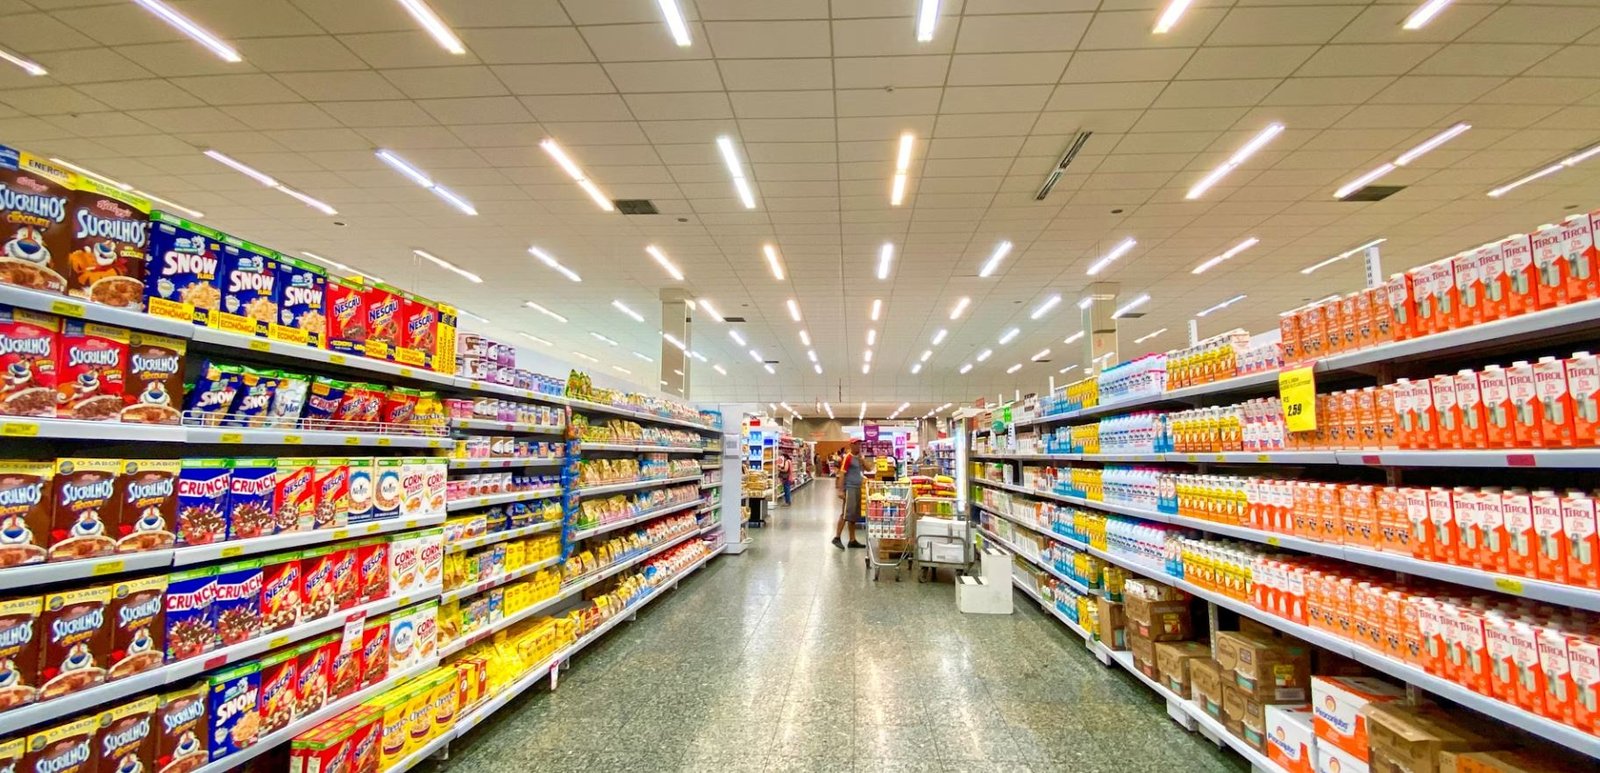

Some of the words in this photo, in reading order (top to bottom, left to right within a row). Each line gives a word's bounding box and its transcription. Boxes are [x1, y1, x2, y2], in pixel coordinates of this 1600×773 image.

[77, 208, 146, 248] SUCRILHOS
[1561, 224, 1591, 241] TIROL
[1504, 245, 1529, 259] TIROL
[1533, 235, 1561, 250] TIROL
[162, 251, 217, 275] SNOW
[1456, 260, 1478, 274] TIROL
[1478, 252, 1503, 267] TIROL
[229, 271, 274, 292] SNOW
[285, 286, 322, 307] SNOW
[334, 295, 361, 315] NESCAU
[150, 306, 192, 321] ECONÔMICA
[369, 301, 398, 322] NESCAU
[408, 312, 434, 332] NESCAU
[69, 347, 120, 367] SUCRILHOS
[132, 354, 178, 374] SUCRILHOS
[1481, 377, 1506, 390] TIROL
[1508, 374, 1533, 388] TIROL
[1535, 370, 1564, 384] TIROL
[1568, 367, 1598, 381] TIROL
[1433, 382, 1454, 395] TIROL
[1456, 380, 1478, 393] TIROL
[199, 389, 237, 407] SNOW
[179, 476, 229, 497] CRUNCH
[231, 475, 276, 495] CRUNCH
[283, 472, 310, 497] NESCAU
[322, 473, 349, 493] NESCAU
[403, 474, 422, 488] CORN
[427, 473, 445, 487] CORN
[62, 479, 114, 506] SUCRILHOS
[128, 478, 173, 504] SUCRILHOS
[1476, 501, 1501, 513] TIROL
[1504, 504, 1531, 516] TIROL
[1535, 505, 1560, 517] TIROL
[1563, 507, 1594, 520] TIROL
[362, 550, 385, 576] NESCAU
[394, 547, 416, 567] CORN
[421, 545, 440, 561] CORN
[217, 572, 263, 599] CRUNCH
[264, 566, 298, 600] NESCAU
[305, 562, 332, 592] NESCAU
[77, 588, 111, 598] SABOR
[167, 581, 217, 610] CRUNCH
[120, 594, 162, 628] SUCRILHOS
[52, 607, 104, 642] SUCRILHOS
[417, 617, 435, 636] CORN
[364, 629, 387, 658] NESCAU
[1486, 629, 1509, 643] TIROL
[1510, 636, 1535, 650] TIROL
[1539, 643, 1565, 658] TIROL
[1569, 651, 1597, 667] TIROL
[298, 650, 328, 689] NESCAU
[262, 666, 296, 704] NESCAU
[164, 699, 205, 734] SUCRILHOS
[216, 688, 259, 726] SNOW
[104, 717, 150, 756] SUCRILHOS
[355, 721, 382, 759] NESCAU
